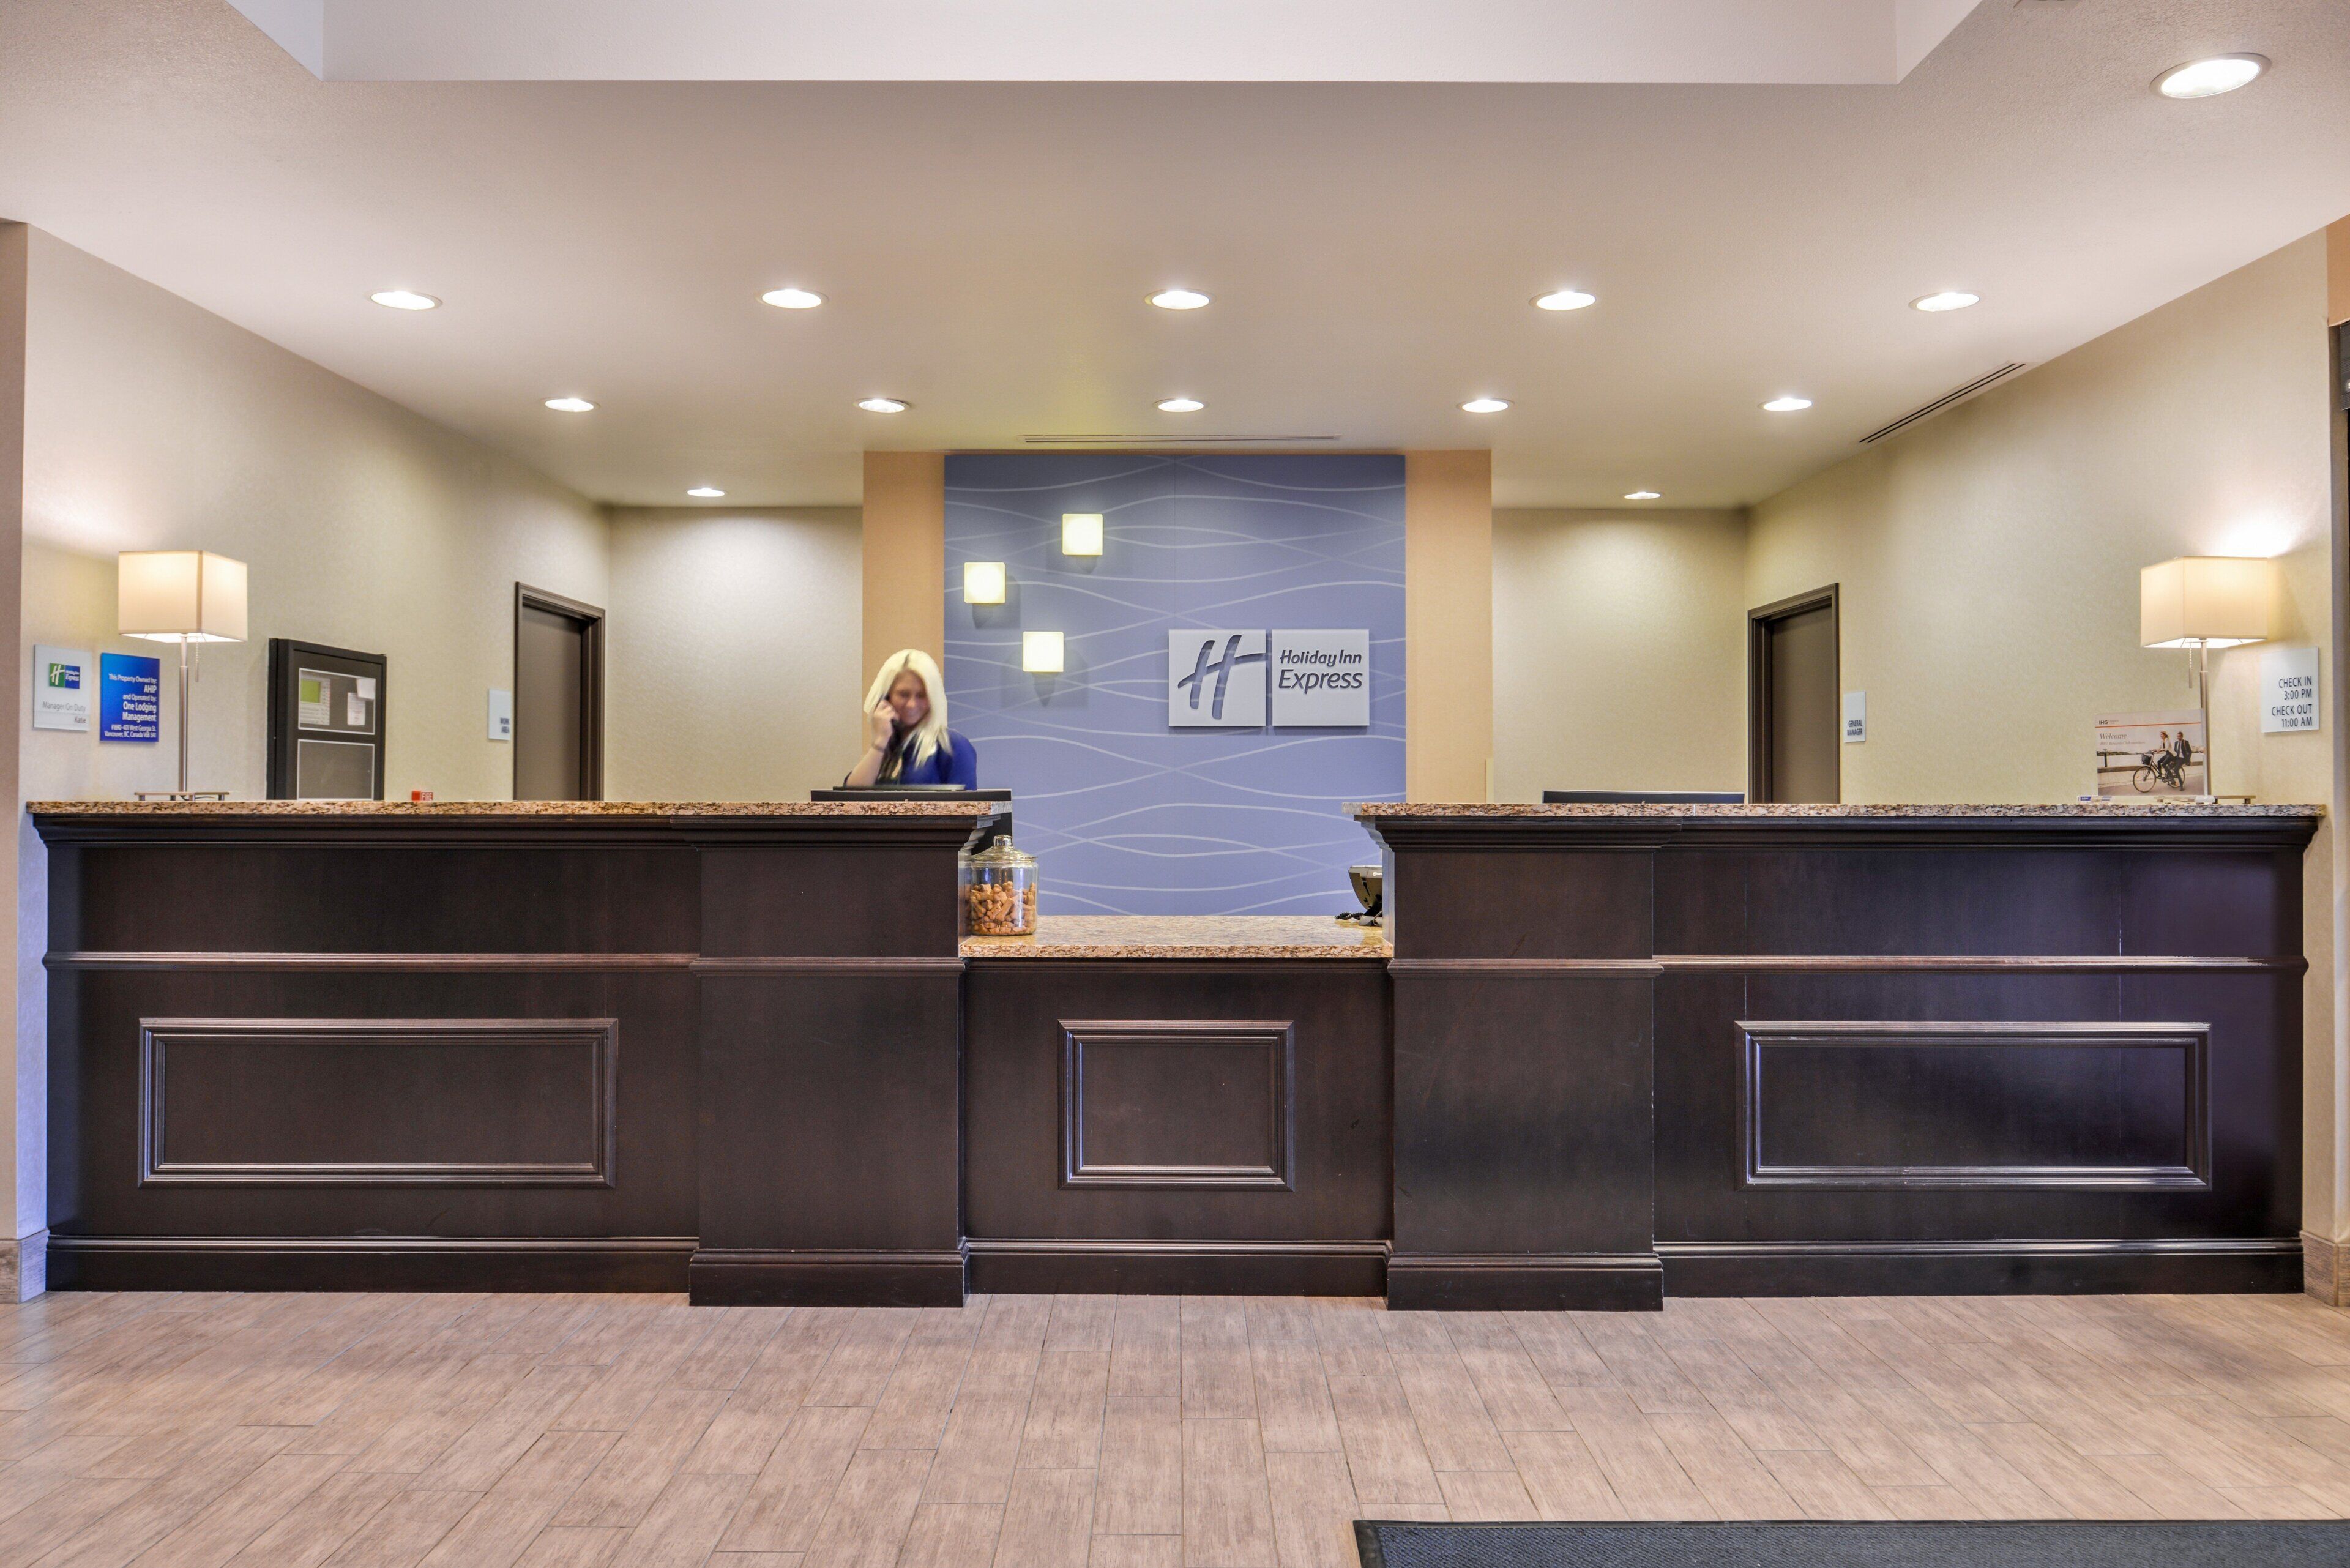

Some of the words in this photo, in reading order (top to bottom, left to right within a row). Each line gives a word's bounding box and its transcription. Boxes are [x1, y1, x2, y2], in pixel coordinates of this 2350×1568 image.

[1280, 649, 1337, 667] Holiday
[1339, 649, 1362, 664] Inn
[118, 674, 135, 683] Property
[1278, 669, 1363, 694] Express
[2278, 676, 2302, 688] CHECK
[2304, 676, 2312, 686] IN
[2284, 690, 2299, 700] 3:00
[2301, 688, 2312, 698] PM
[43, 701, 64, 711] Manager
[74, 704, 86, 713] Duty
[123, 701, 135, 711] One
[135, 702, 157, 714] Lodging
[2272, 705, 2295, 716] CHECK
[2297, 704, 2312, 714] OUT
[122, 712, 157, 723] Management
[2281, 717, 2298, 728] 11:00
[2301, 716, 2313, 726] AM
